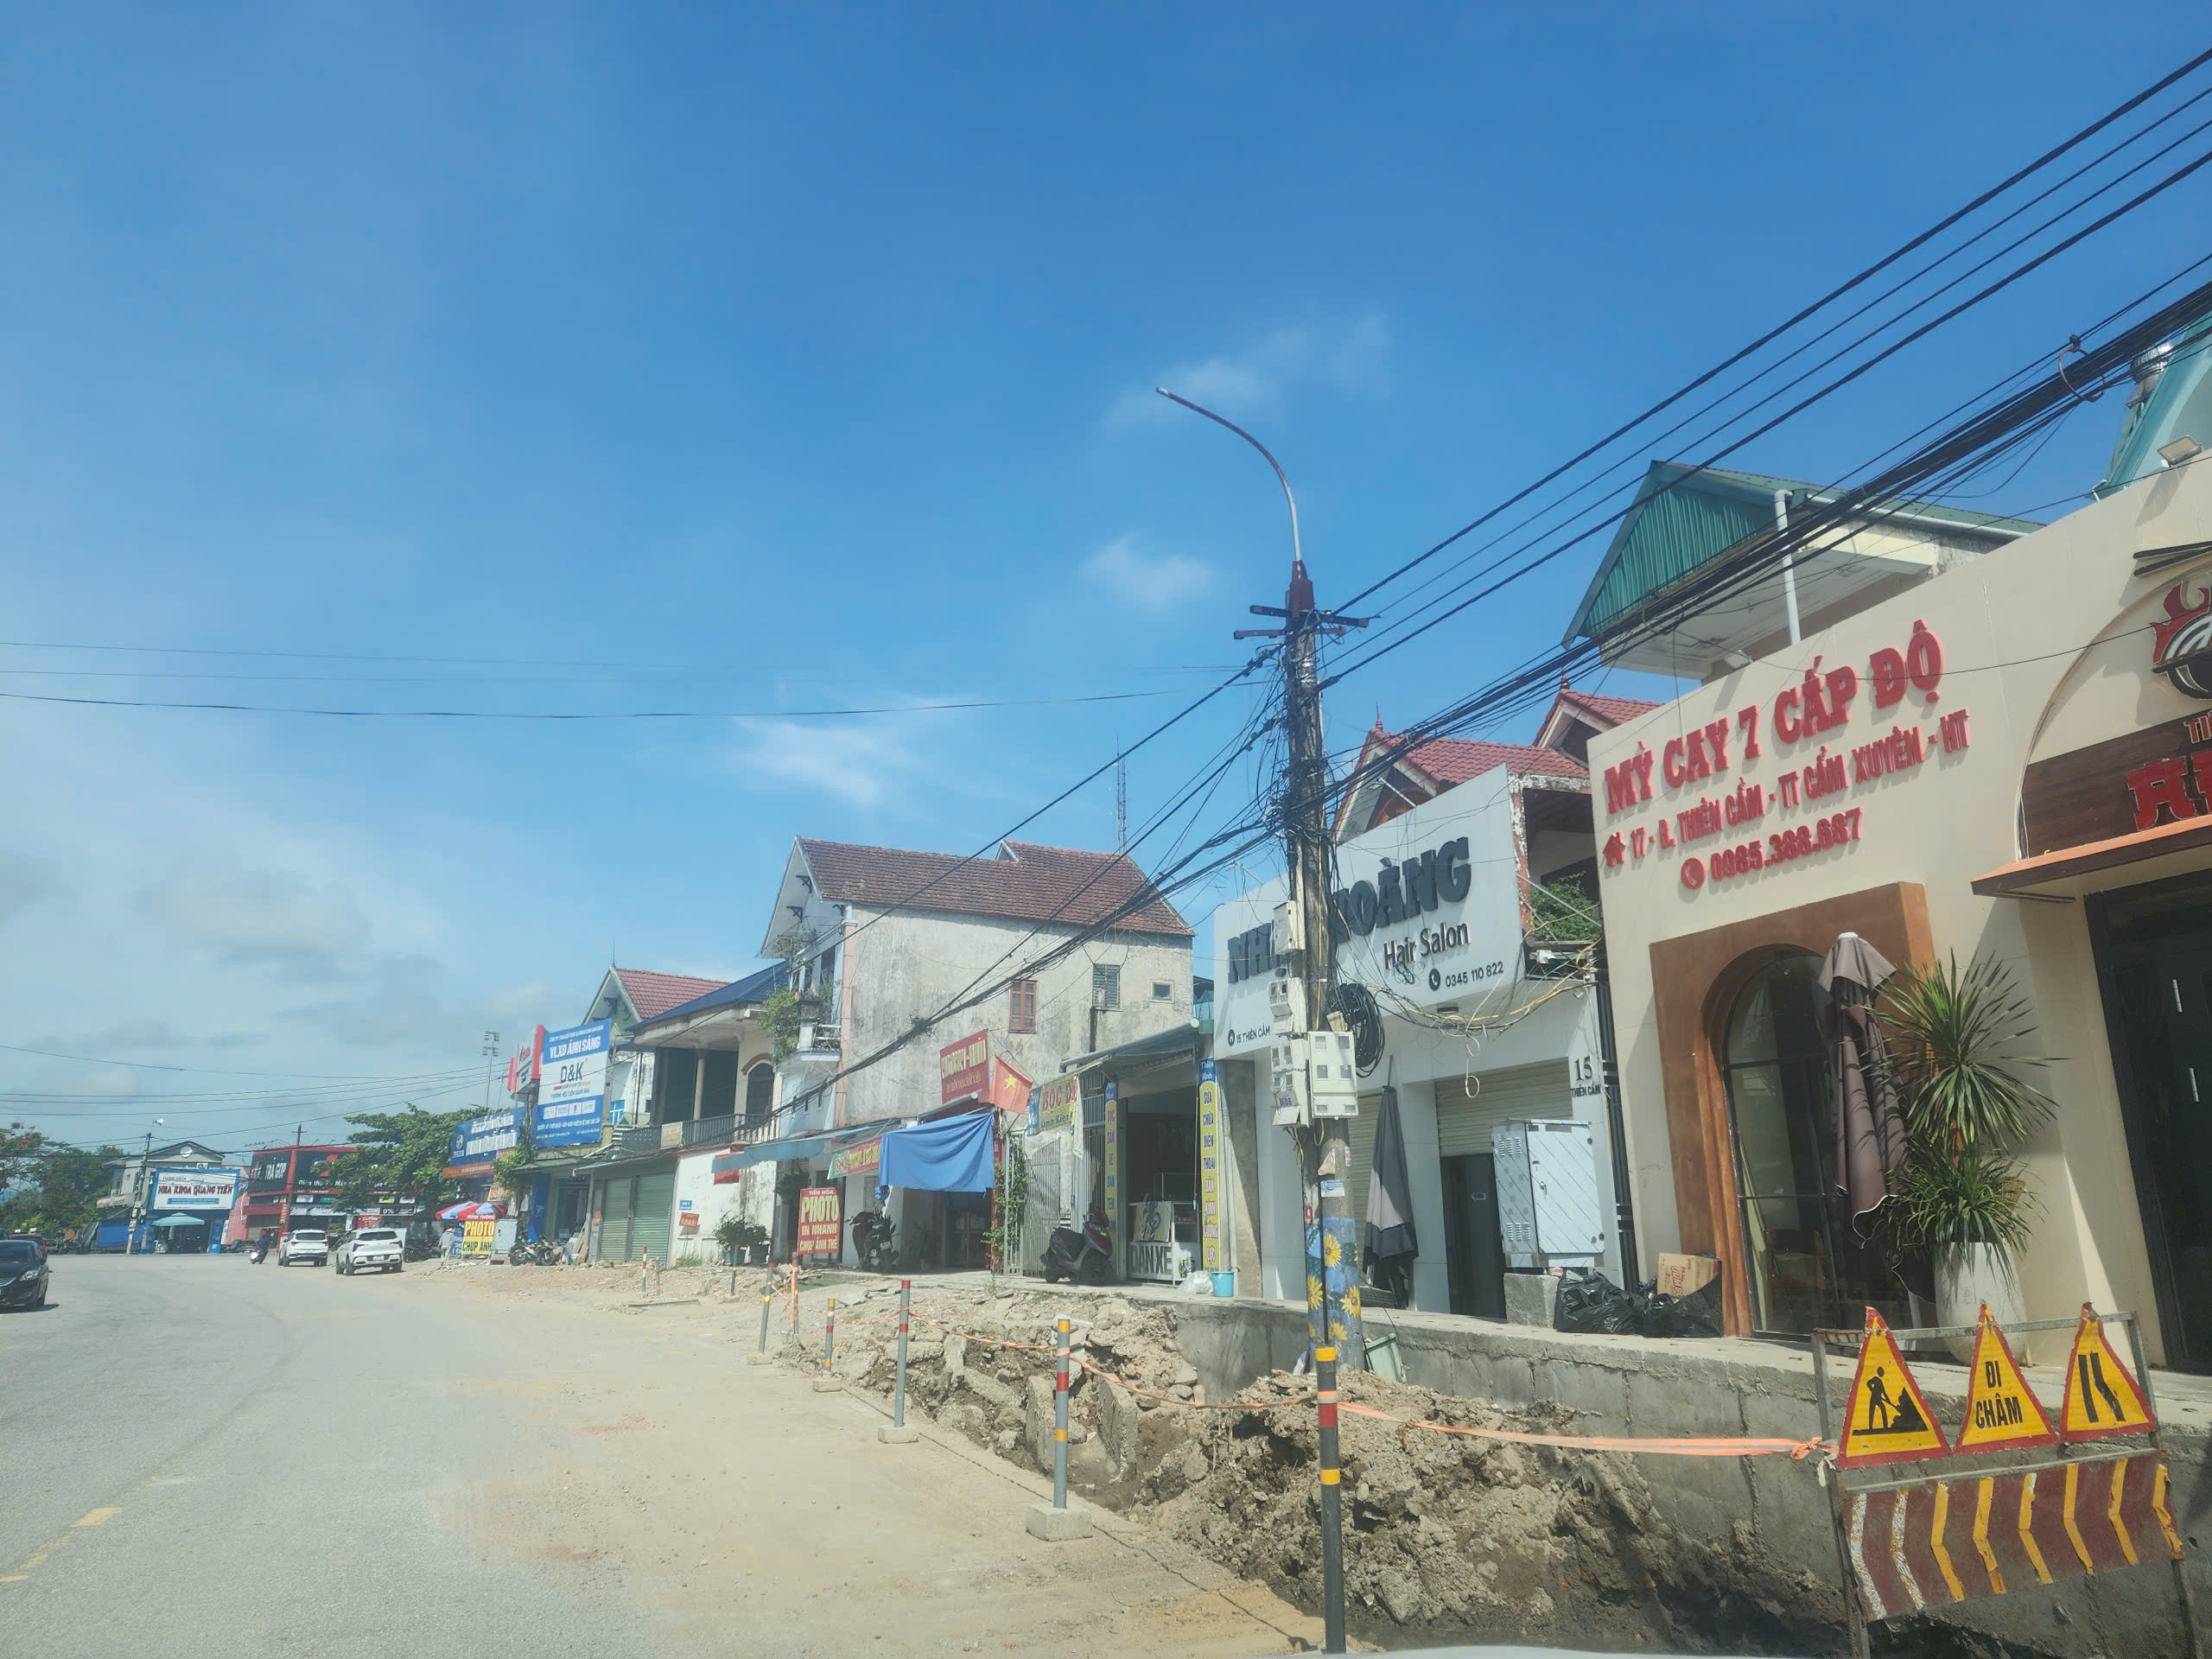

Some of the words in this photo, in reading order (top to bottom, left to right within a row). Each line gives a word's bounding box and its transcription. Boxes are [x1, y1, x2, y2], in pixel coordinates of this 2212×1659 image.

[1663, 717, 1730, 789] CAY
[1738, 704, 1761, 760] 7
[1774, 655, 1859, 744] CẤP
[1870, 619, 1943, 709] ĐỘ
[1676, 797, 1724, 843] THIÊN
[1778, 771, 1800, 809] TT
[1852, 726, 1924, 784] XUYÊN
[1940, 709, 1970, 754] HT
[1384, 937, 1417, 970] Hair
[1420, 922, 1471, 957] Salon
[1445, 971, 1469, 988] 0345
[1471, 967, 1484, 982] 110
[1486, 961, 1504, 977] 822
[560, 1061, 583, 1084] D&K
[1574, 1055, 1593, 1081] 15
[1570, 1084, 1587, 1098] THIÊN
[801, 1195, 839, 1223] PHOTO
[463, 1221, 495, 1236] PHOTO
[801, 1224, 810, 1236] IN
[811, 1224, 837, 1236] NHANH
[1986, 1361, 2002, 1389] ĐI
